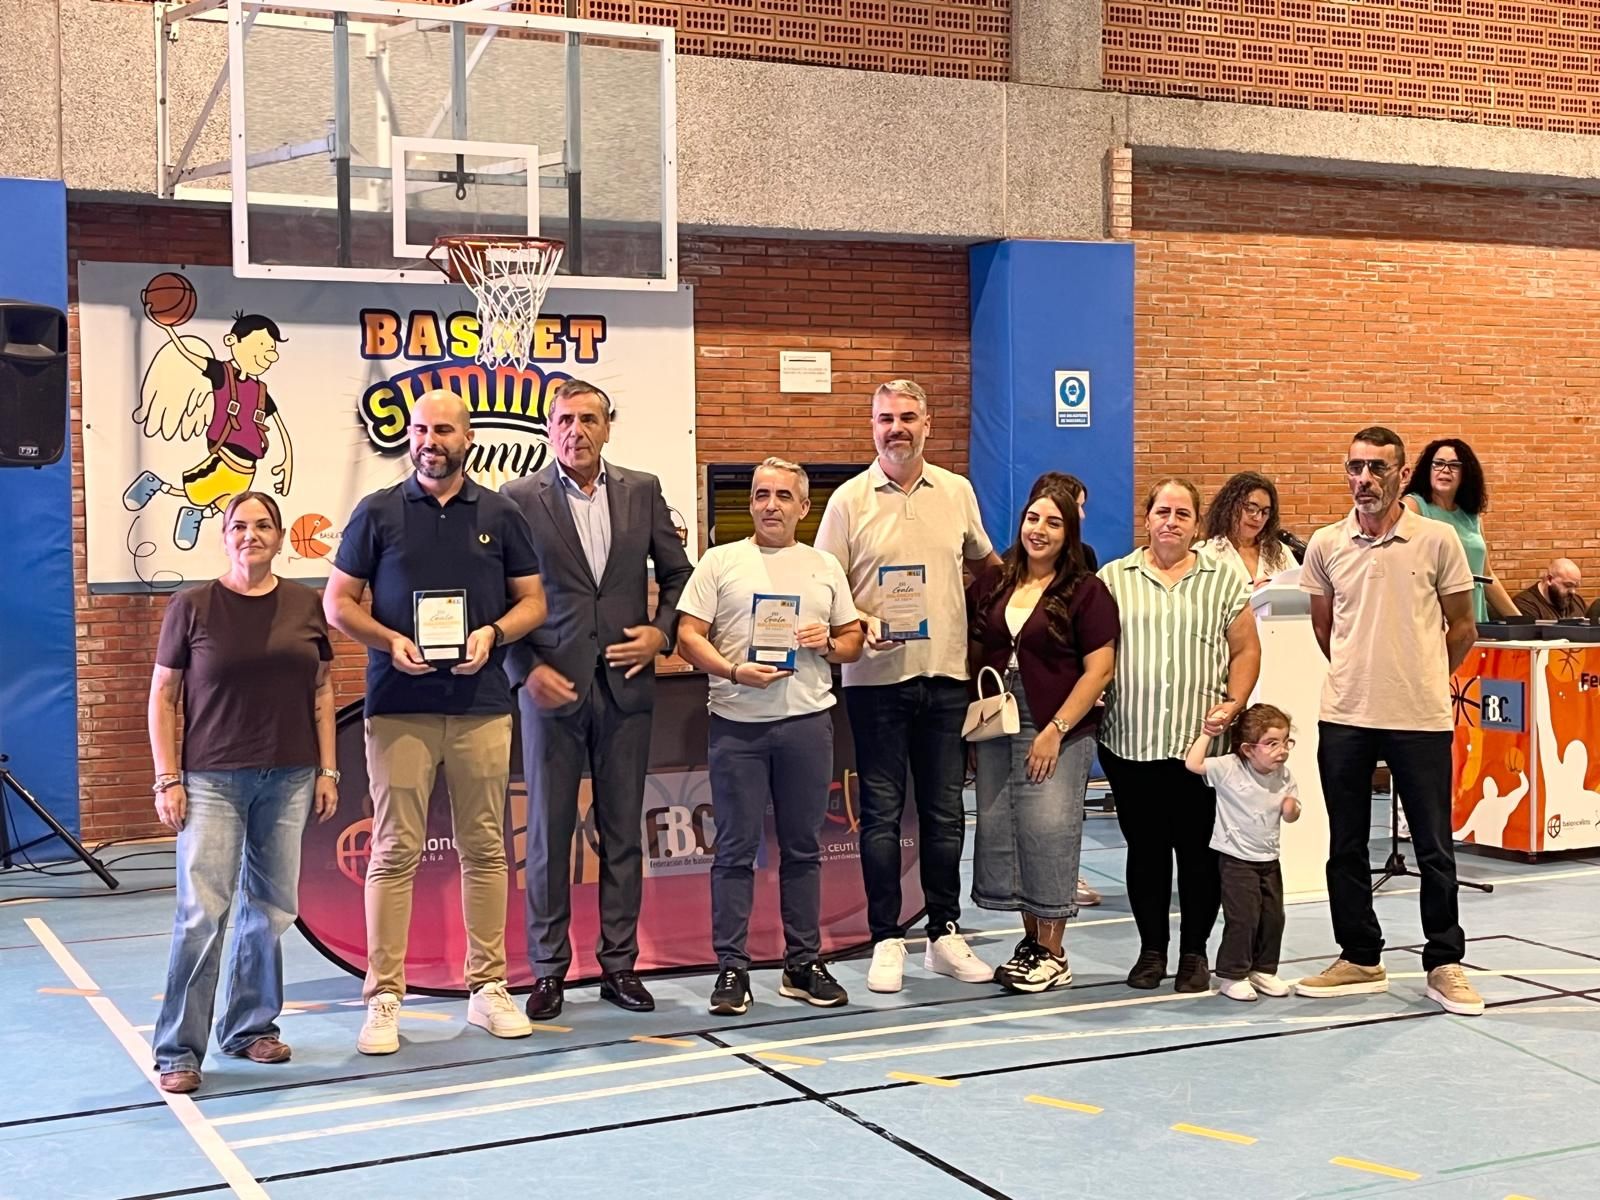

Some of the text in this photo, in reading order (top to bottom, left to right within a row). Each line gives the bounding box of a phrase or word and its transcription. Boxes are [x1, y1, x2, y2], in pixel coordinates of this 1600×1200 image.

[460, 442, 548, 478] amp
[1580, 673, 1600, 688] Fe
[422, 853, 444, 862] AÑA
